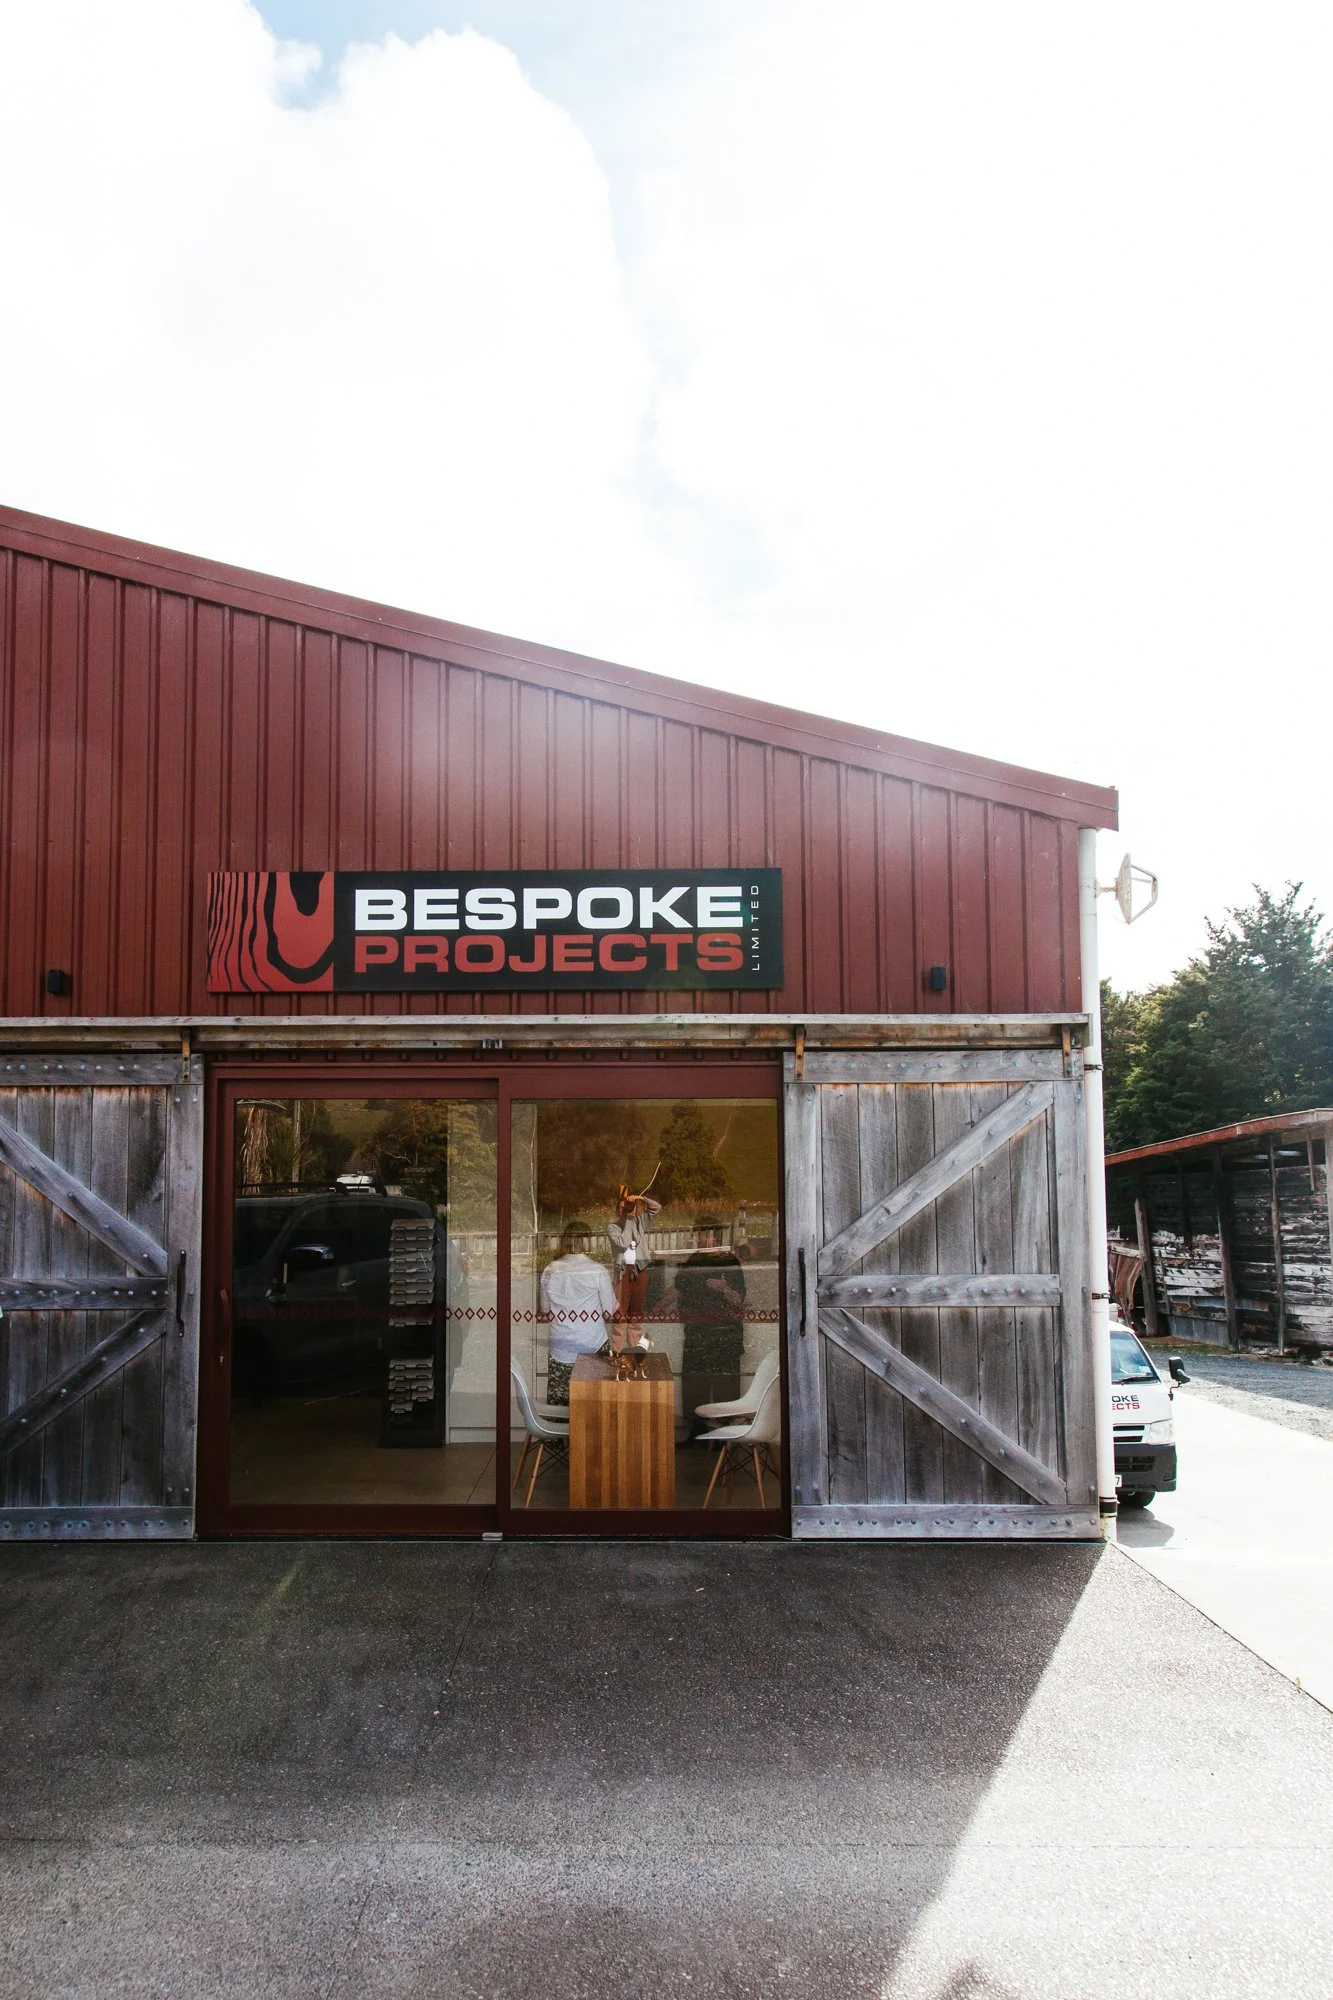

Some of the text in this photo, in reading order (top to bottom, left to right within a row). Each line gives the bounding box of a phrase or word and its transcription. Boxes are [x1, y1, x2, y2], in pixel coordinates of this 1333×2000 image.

[355, 886, 744, 931] BESPOKE
[750, 885, 760, 971] LIMITED
[354, 932, 744, 973] PROJECTS
[1111, 1395, 1139, 1403] OKE
[1111, 1402, 1140, 1411] ECTS
